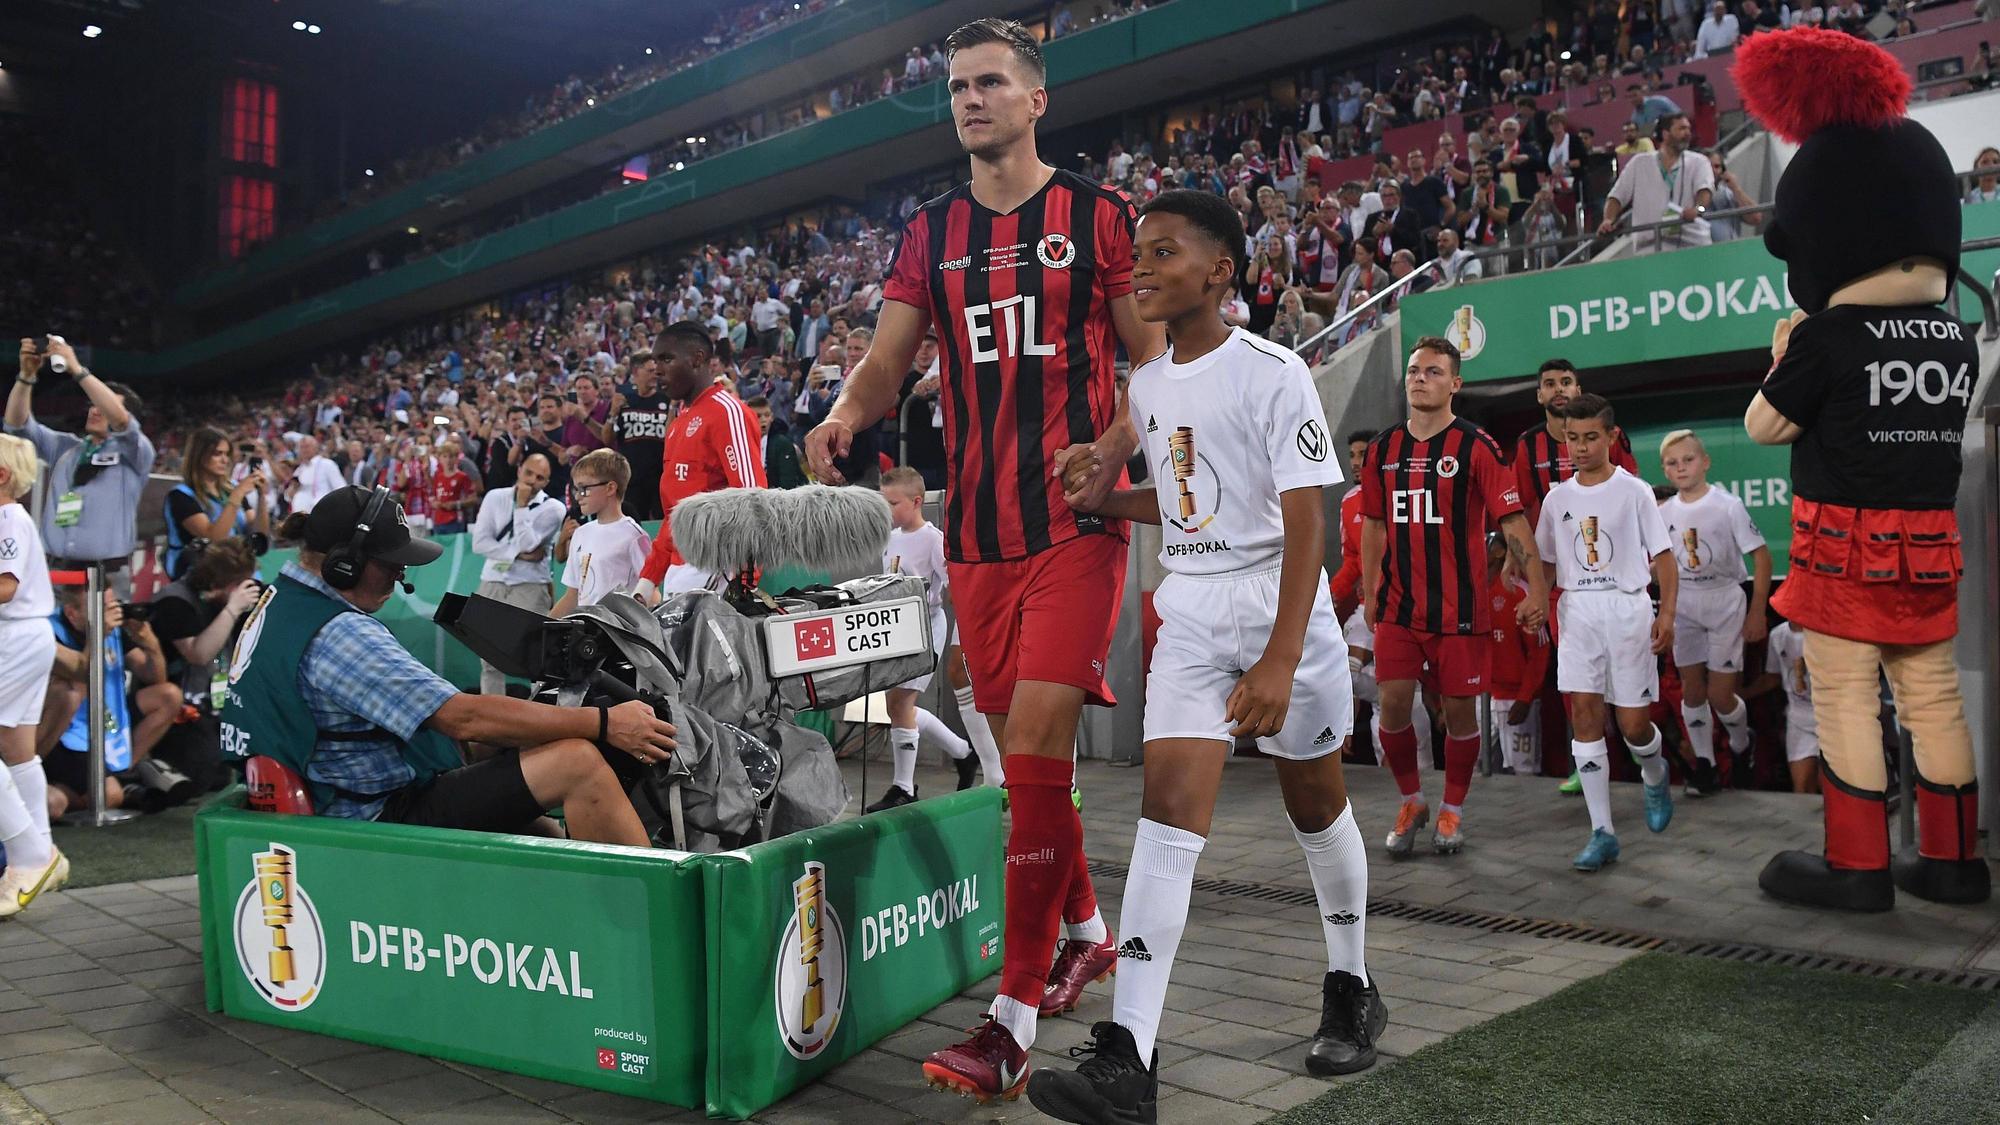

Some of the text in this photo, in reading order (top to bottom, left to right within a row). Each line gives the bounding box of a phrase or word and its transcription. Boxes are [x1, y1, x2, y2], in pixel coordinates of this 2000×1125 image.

[939, 255, 972, 270] capelli
[964, 294, 1056, 363] ETL
[1864, 319, 1963, 341] VIKTOR
[1864, 360, 1970, 407] 1904
[624, 422, 666, 439] 2020
[1868, 430, 1938, 442] VIKTORIA
[1392, 488, 1444, 524] ETL
[1167, 540, 1231, 557] DFB-POKAL
[845, 608, 901, 631] SPORT
[847, 631, 891, 652] CAST
[861, 874, 980, 962] DFB-POKAL
[350, 920, 594, 999] DFB-POKAL
[1117, 946, 1152, 962] adidas
[594, 1027, 648, 1045] produced by
[620, 1051, 650, 1066] SPORT
[621, 1062, 645, 1075] CAST
